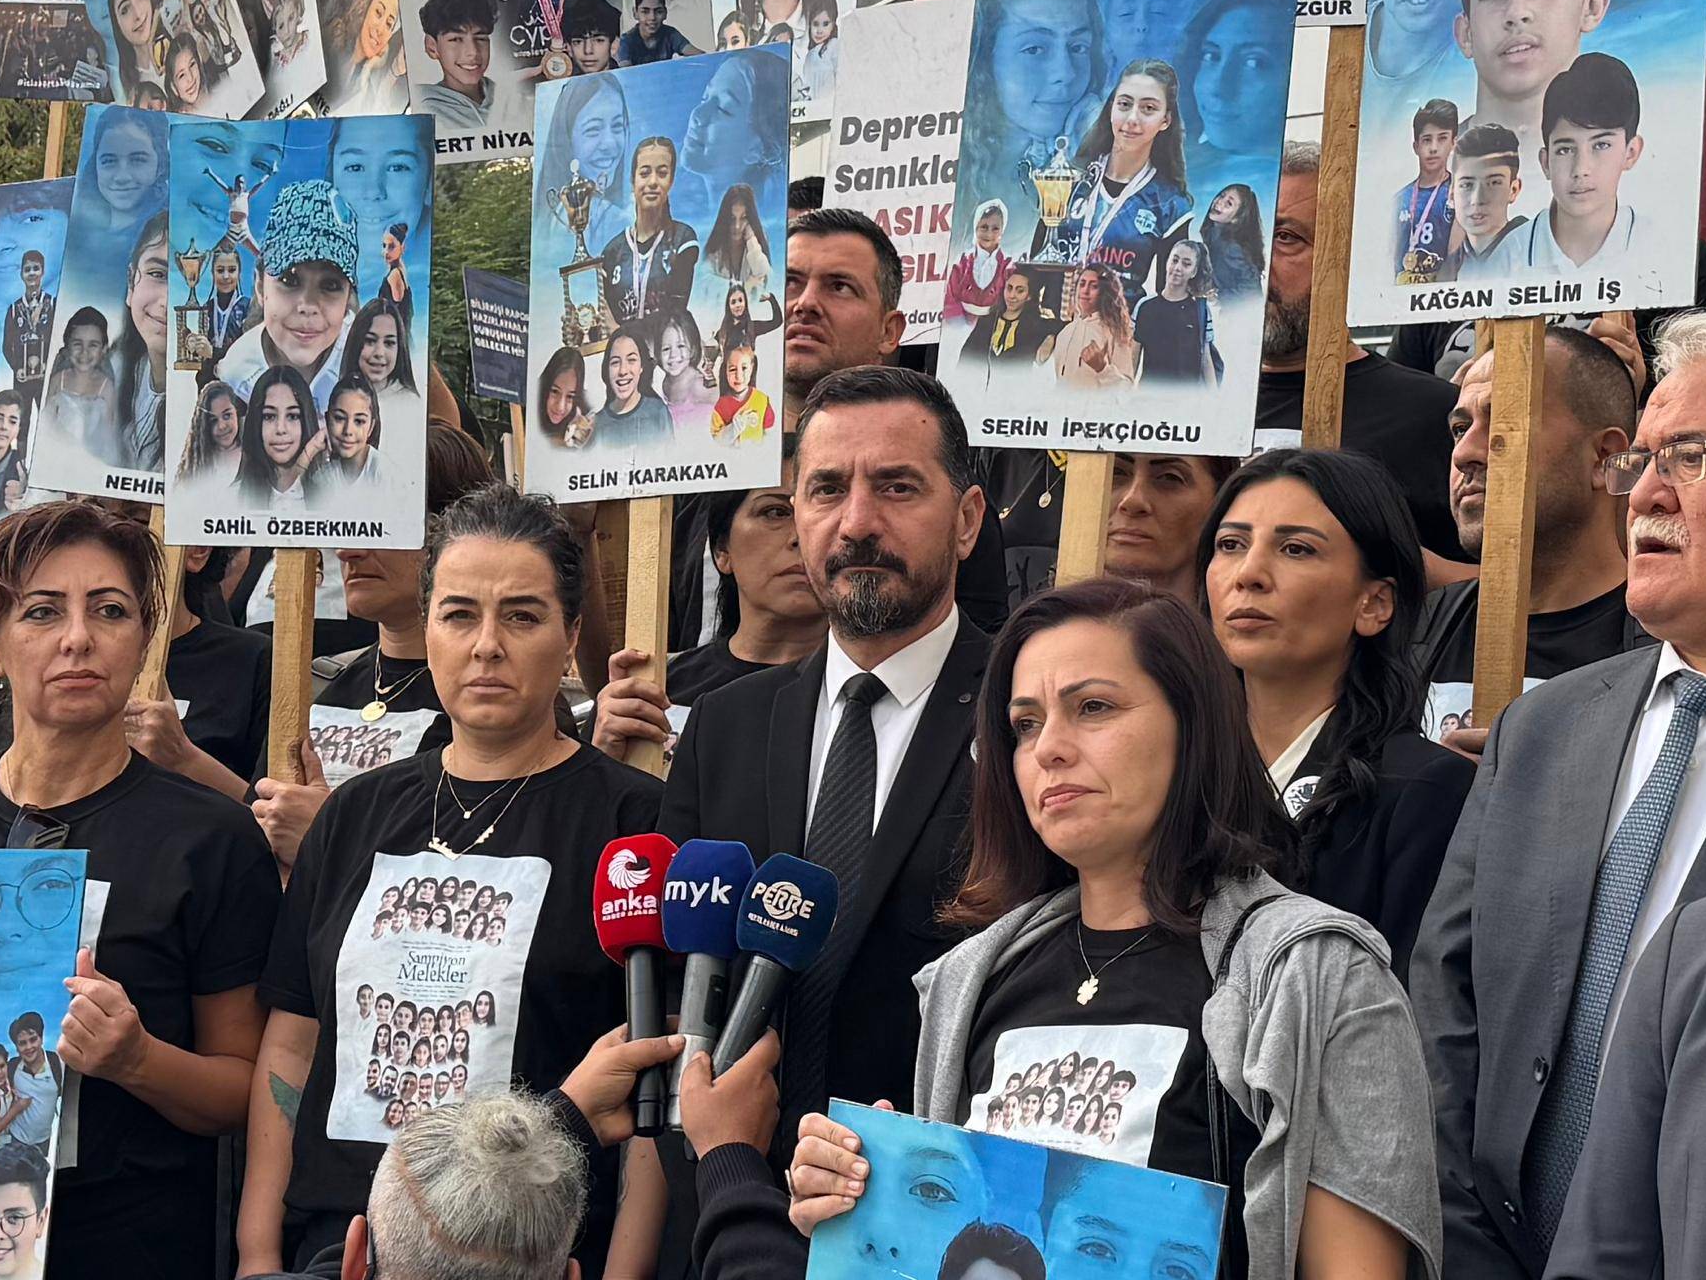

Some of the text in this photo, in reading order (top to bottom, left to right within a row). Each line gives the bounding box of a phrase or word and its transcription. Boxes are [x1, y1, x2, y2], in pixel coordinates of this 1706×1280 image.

[1410, 278, 1622, 312] KAĞAN SELİM İŞ
[981, 416, 1201, 443] SERİN İPEKÇİOĞLU
[105, 474, 165, 496] NEHİR
[568, 463, 729, 491] SELİN KARAKAYA
[202, 517, 383, 538] SAHİL ÖZBERKMAN
[601, 889, 657, 915] anka
[664, 875, 733, 908] myk
[750, 881, 816, 919] PERRE
[396, 963, 468, 983] Melekler
